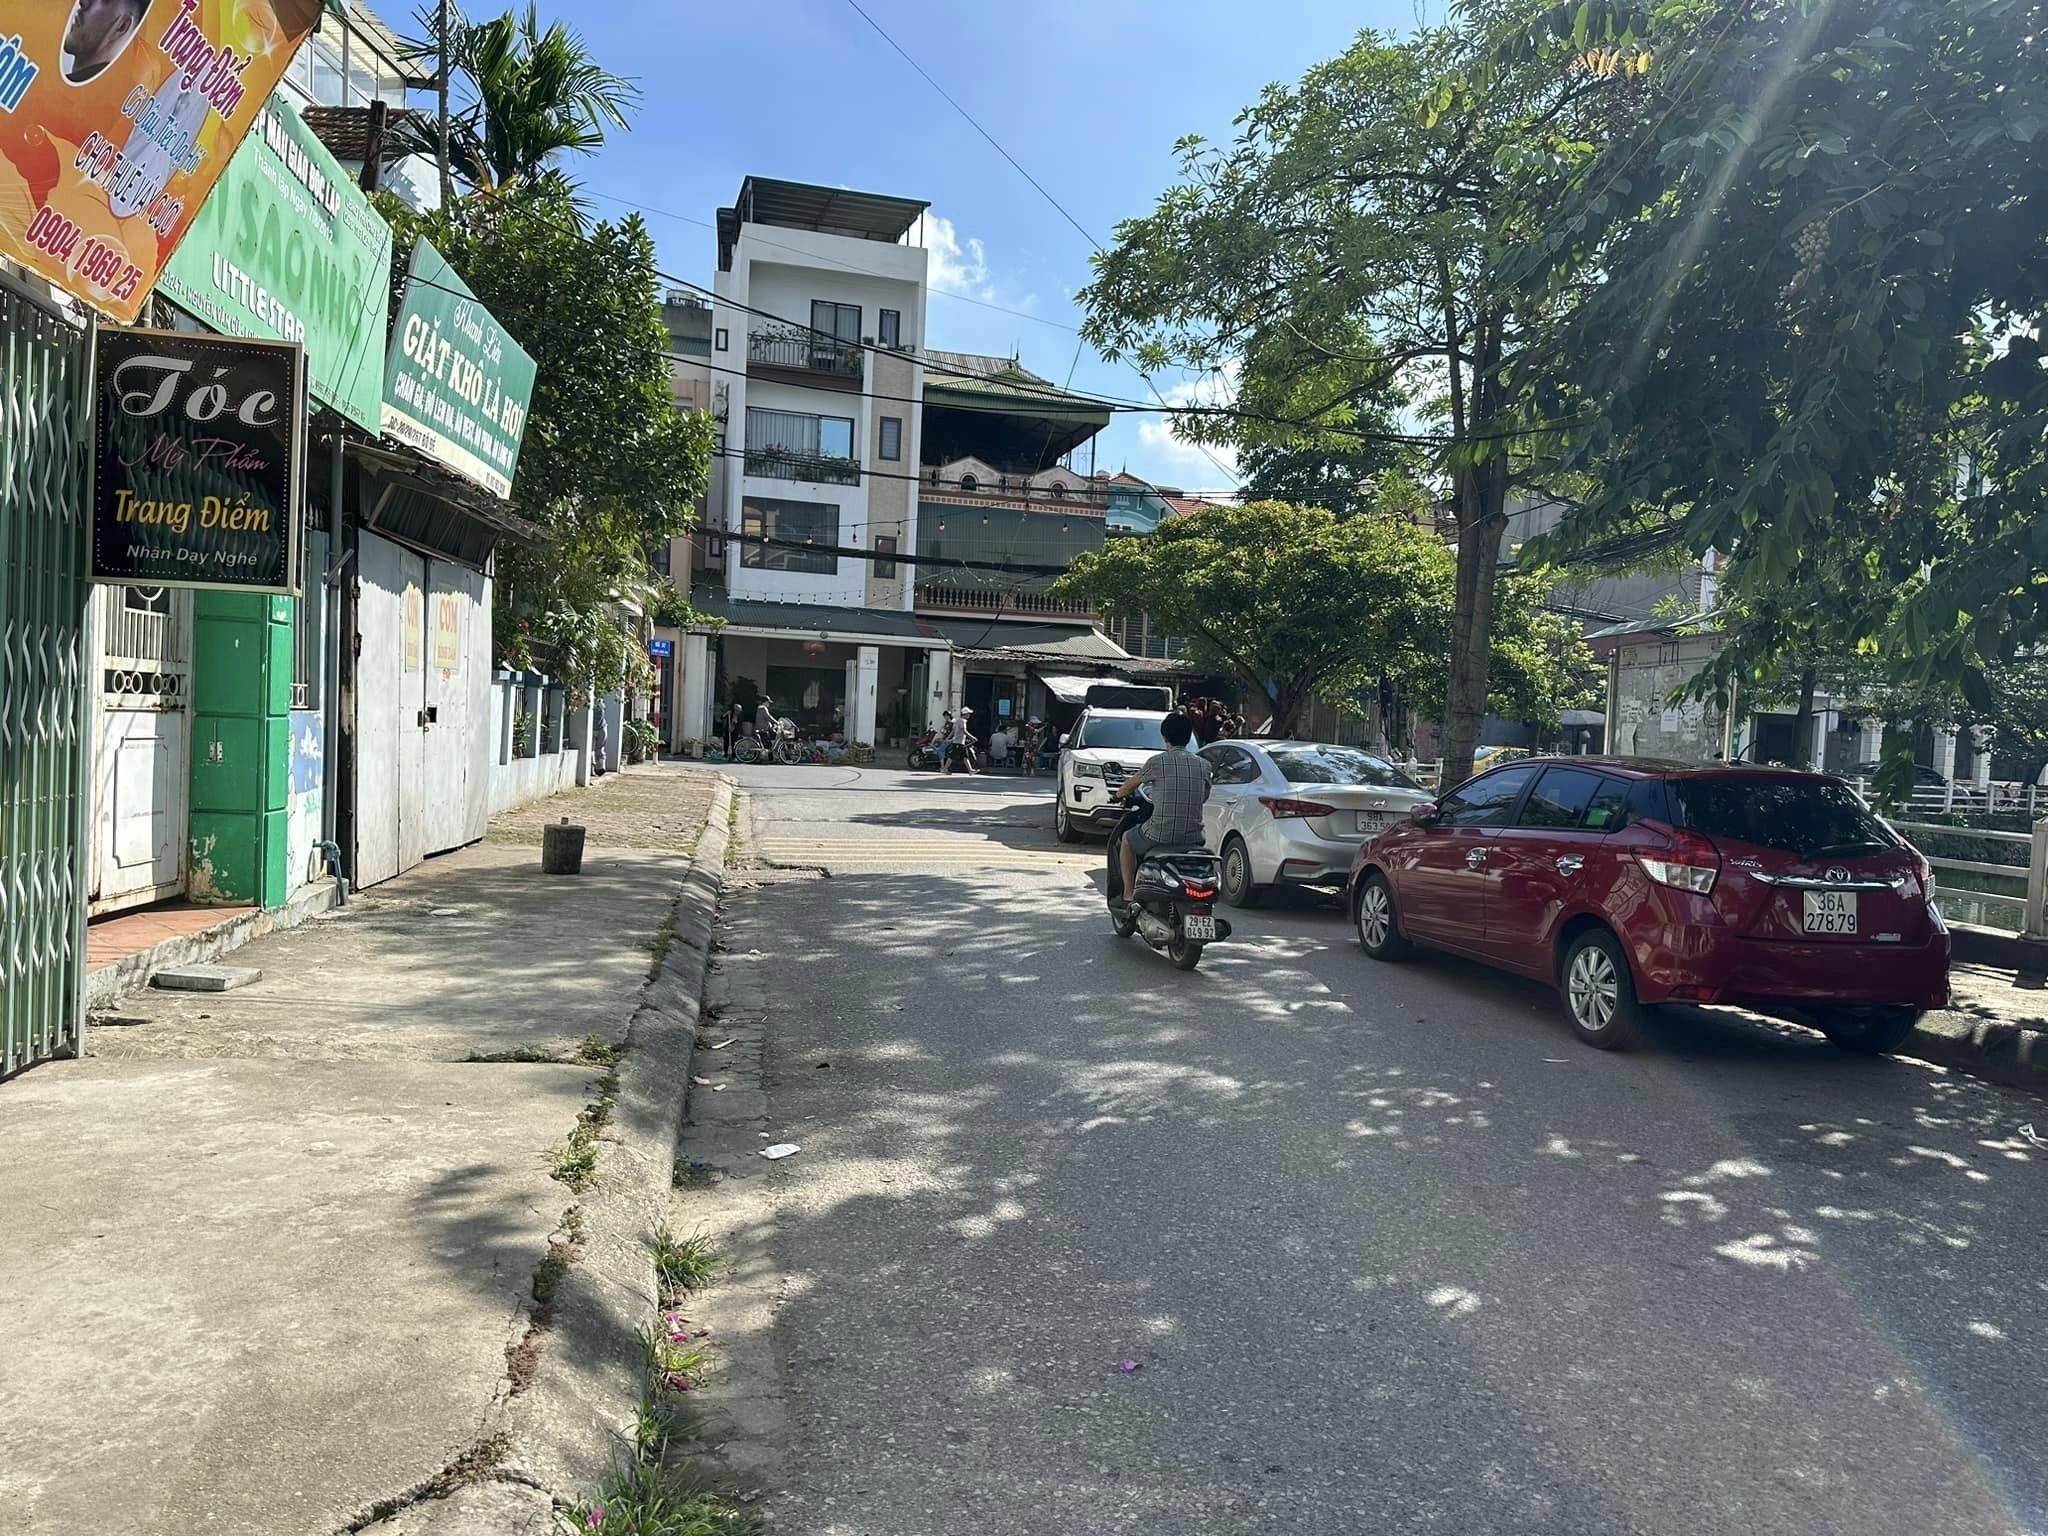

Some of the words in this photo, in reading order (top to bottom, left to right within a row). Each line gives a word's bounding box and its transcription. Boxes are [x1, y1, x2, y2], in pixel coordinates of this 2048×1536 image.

[159, 0, 210, 90] Trang
[200, 46, 251, 121] Điểm
[121, 85, 147, 118] Cô
[74, 131, 114, 180] CHO
[101, 151, 146, 203] THUÊ
[128, 174, 162, 218] VÁY
[26, 207, 81, 263] 0904
[73, 236, 121, 288] 1969
[113, 264, 144, 301] 25
[212, 251, 267, 321] LITTLE
[267, 297, 304, 342] STAR
[112, 354, 279, 426] Tóc
[402, 313, 450, 382] GIẶT
[449, 358, 483, 408] KHÔ
[482, 376, 502, 424] LÀ
[500, 393, 524, 442] HƠI
[115, 489, 191, 534] Trang
[200, 491, 269, 532] Điểm
[176, 547, 209, 565] Dạy
[1807, 912, 1856, 933] 278.79
[1817, 892, 1845, 912] 36A
